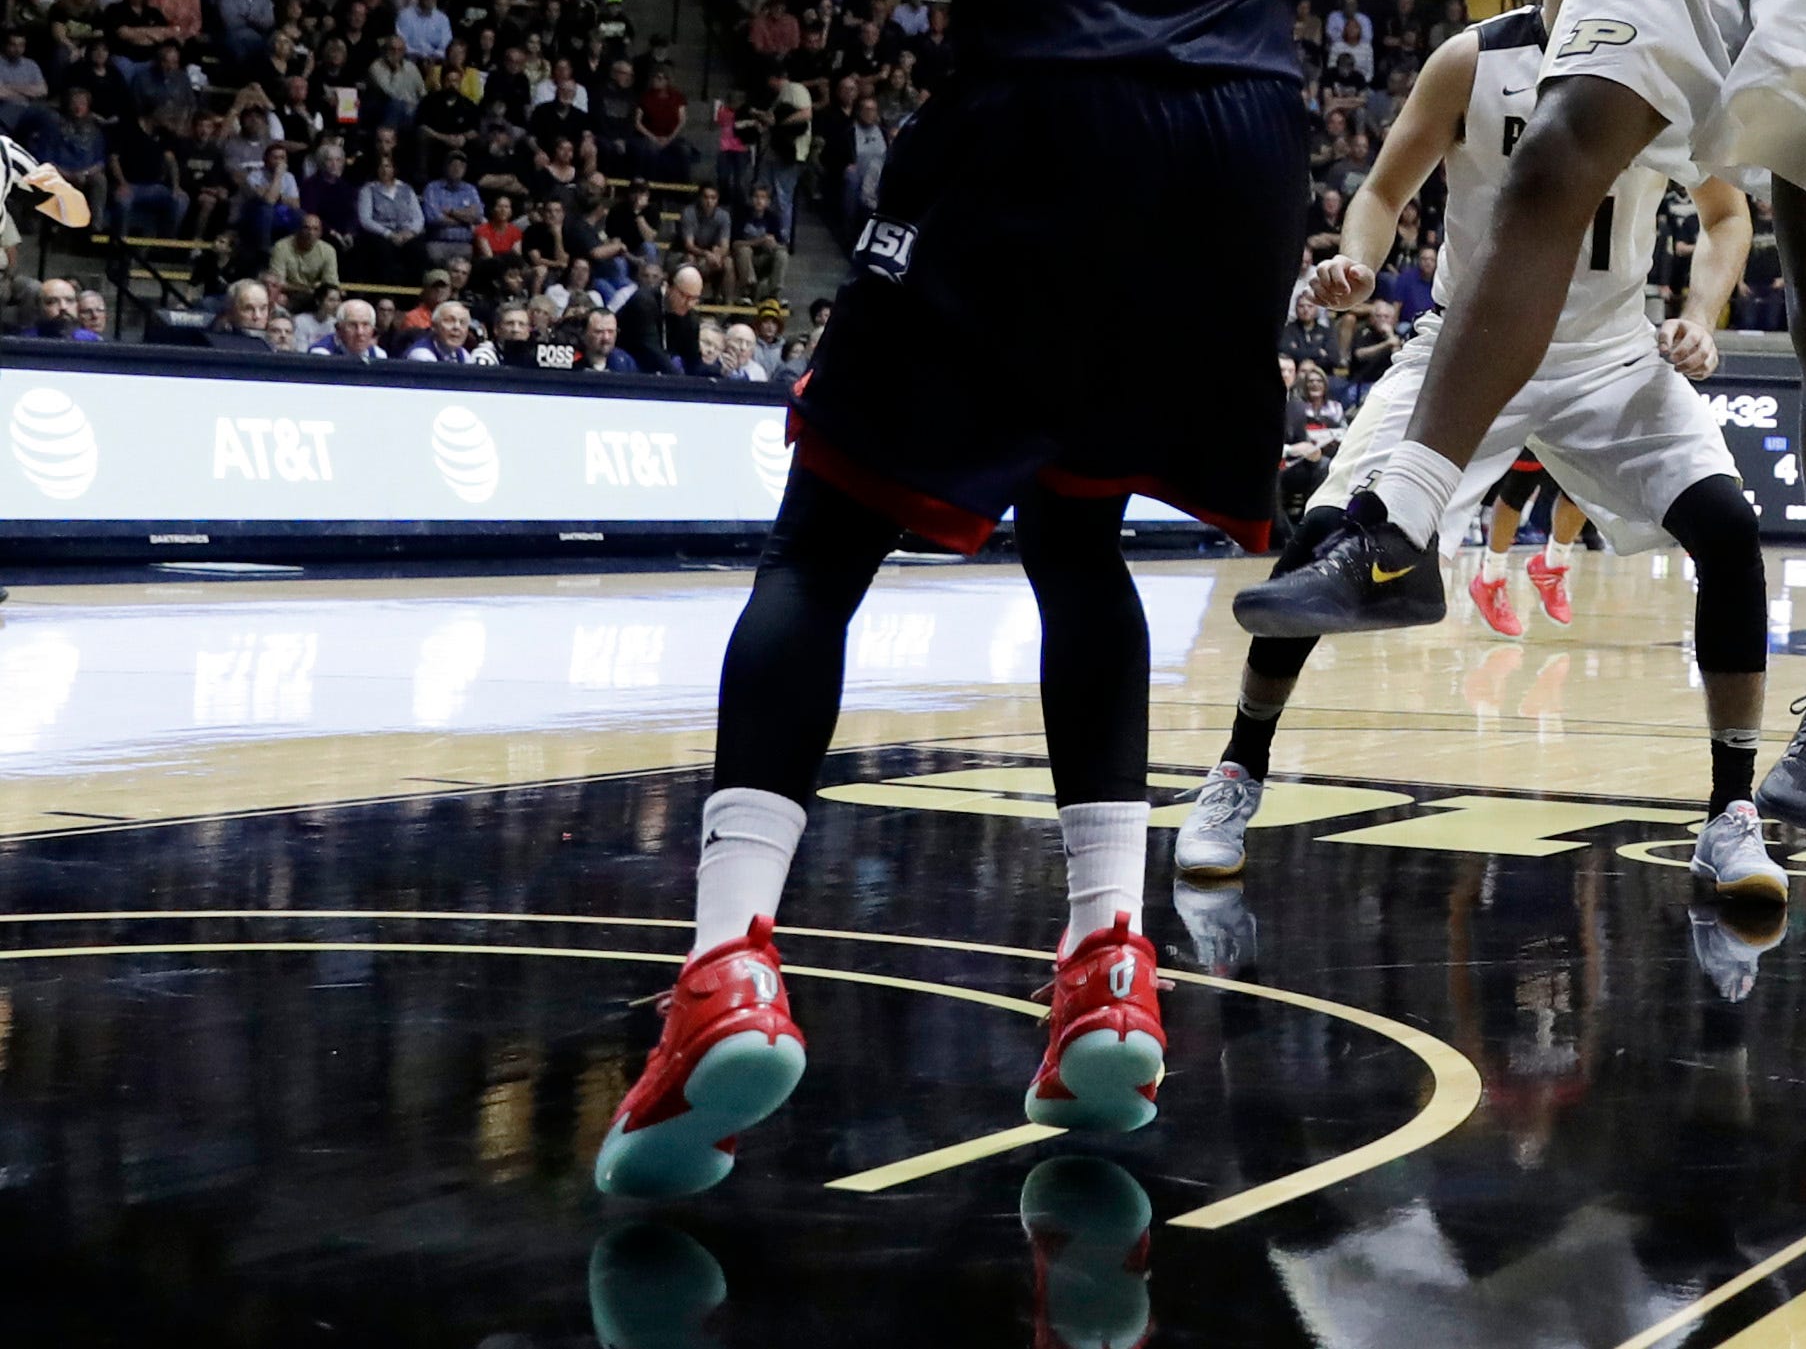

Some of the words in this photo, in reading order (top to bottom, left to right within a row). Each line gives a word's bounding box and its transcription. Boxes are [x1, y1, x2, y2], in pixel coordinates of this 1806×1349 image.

[537, 344, 574, 364] POSS
[212, 416, 335, 482] AT&T
[584, 429, 677, 487] AT&T
[1774, 453, 1799, 485] 4
